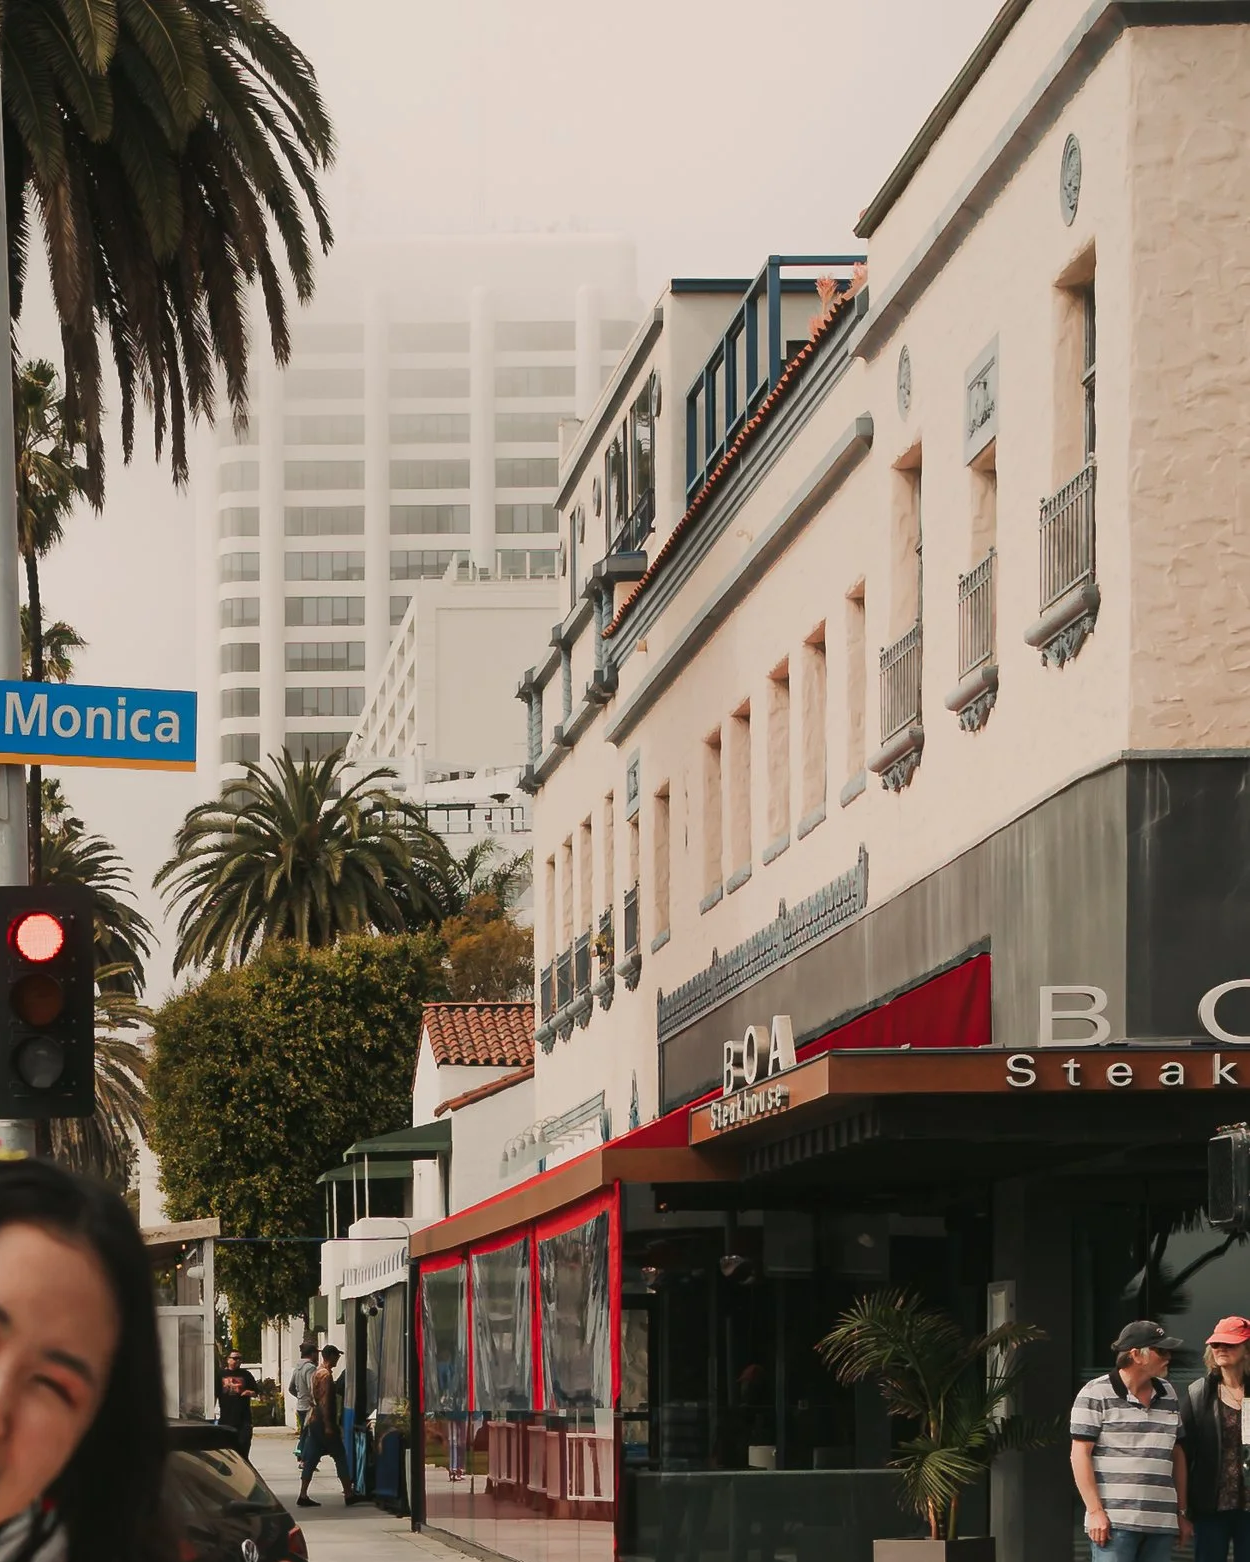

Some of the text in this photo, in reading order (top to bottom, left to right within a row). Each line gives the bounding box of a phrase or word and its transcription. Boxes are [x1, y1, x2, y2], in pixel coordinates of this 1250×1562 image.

[4, 691, 180, 744] Monica
[723, 1015, 797, 1097] BOA
[710, 1083, 785, 1131] Steakhouse
